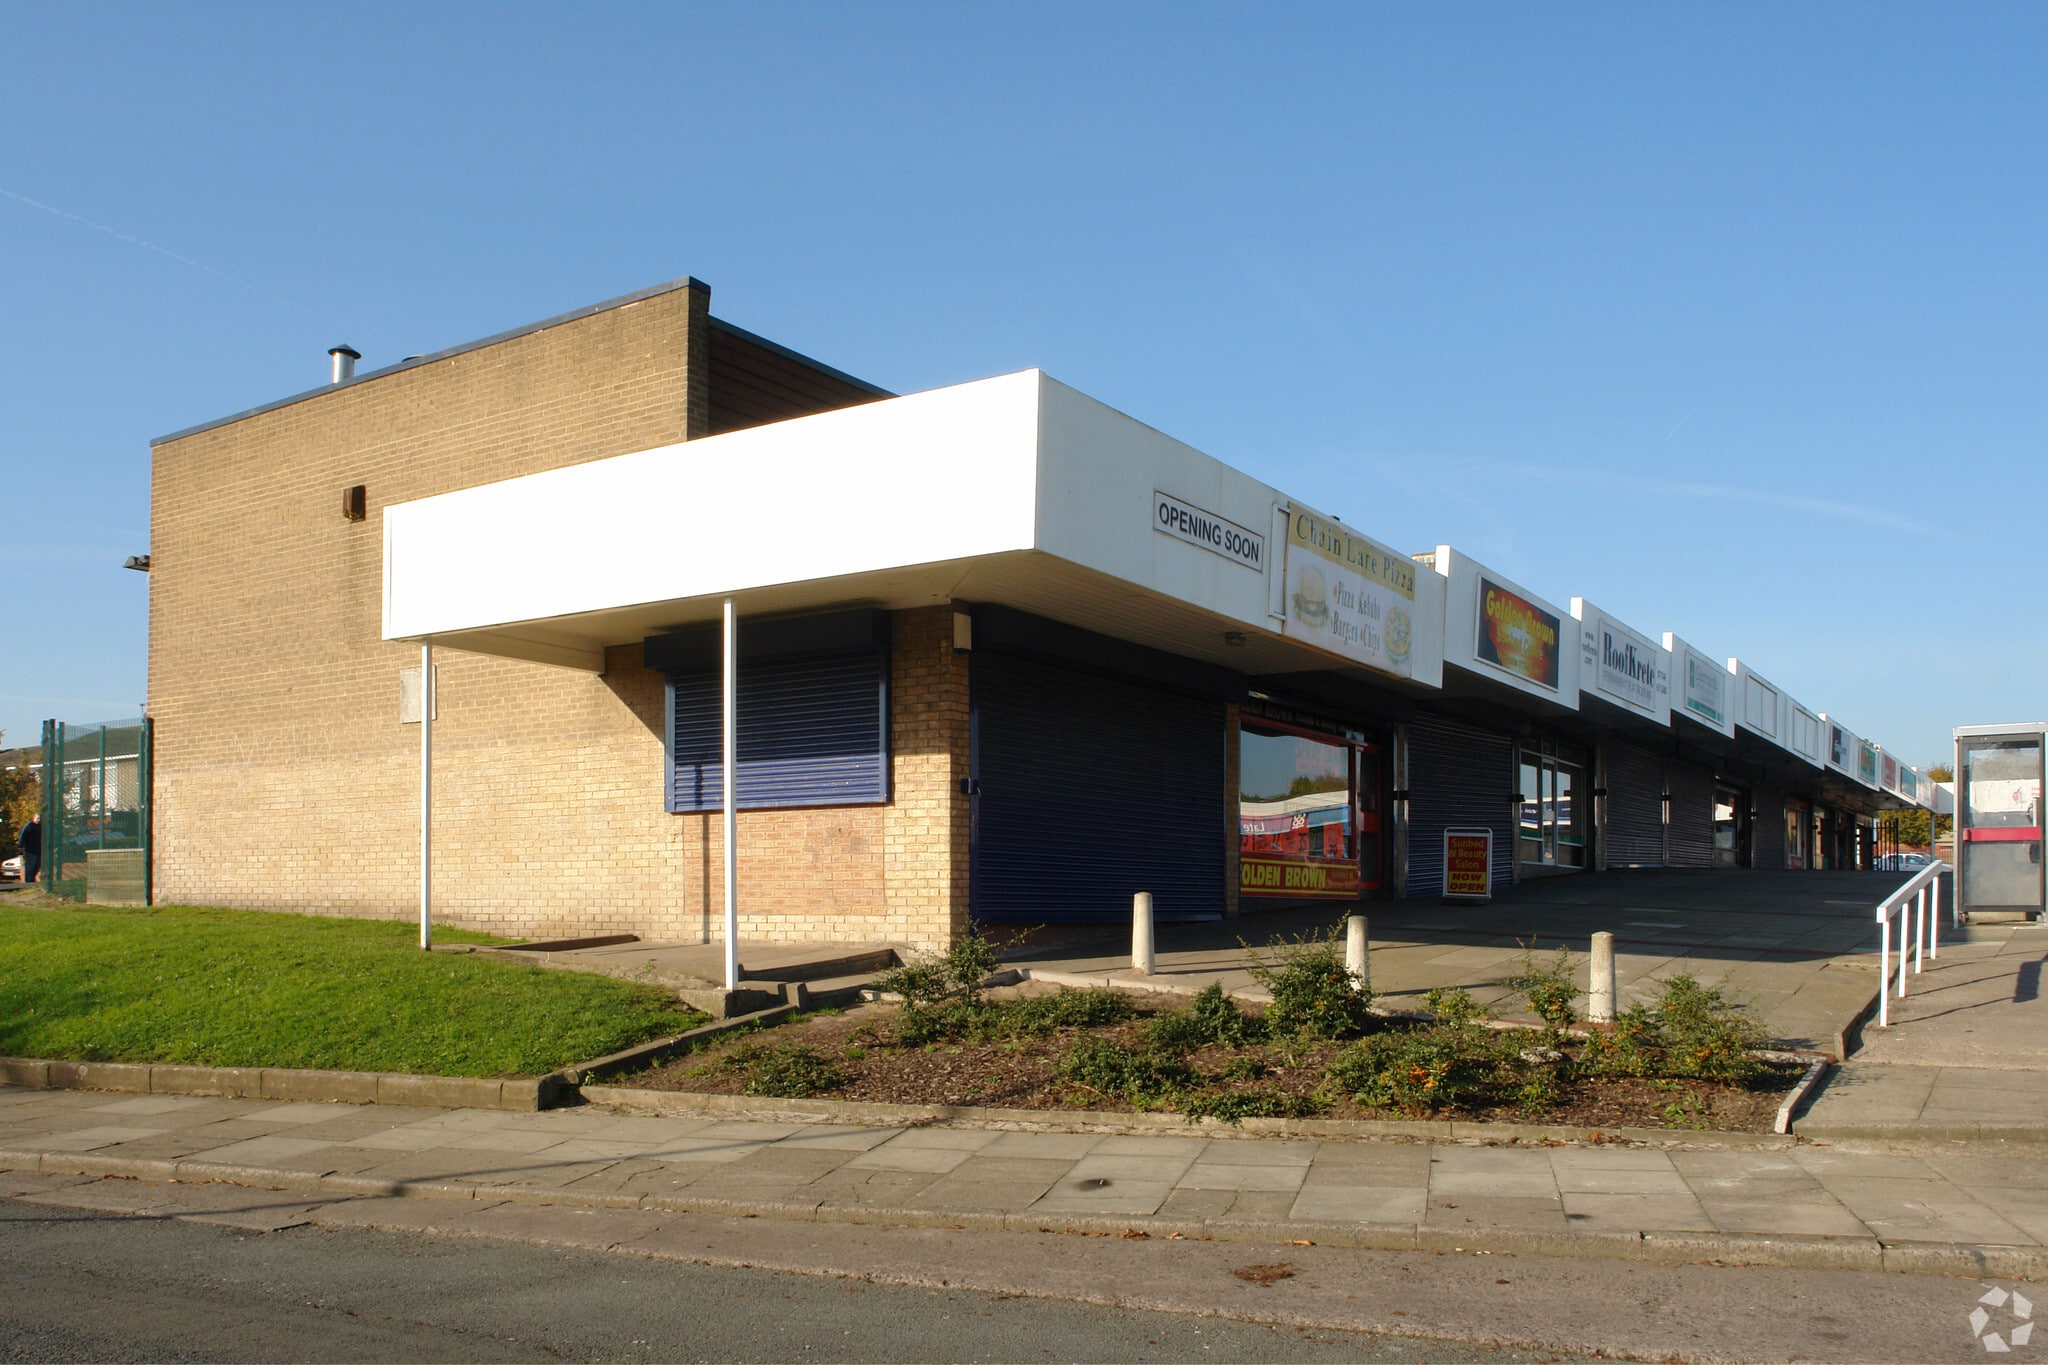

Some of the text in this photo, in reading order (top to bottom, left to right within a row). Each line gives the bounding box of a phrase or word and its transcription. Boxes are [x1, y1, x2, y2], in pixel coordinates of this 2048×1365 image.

[1159, 502, 1260, 563] OPENING SOON
[1296, 514, 1341, 556] Chain
[1383, 556, 1413, 592] Pizza
[1486, 590, 1523, 628] Golden
[1526, 610, 1554, 646] Brown
[1603, 631, 1656, 687] RoofKrete
[1452, 838, 1484, 849] Sunbed
[1458, 848, 1487, 859] Beauty
[1455, 859, 1479, 869] Salon
[1240, 863, 1280, 885] OLDEN
[1284, 866, 1326, 888] BROWN
[1452, 872, 1482, 881] NOW
[1449, 882, 1485, 891] OPEN
